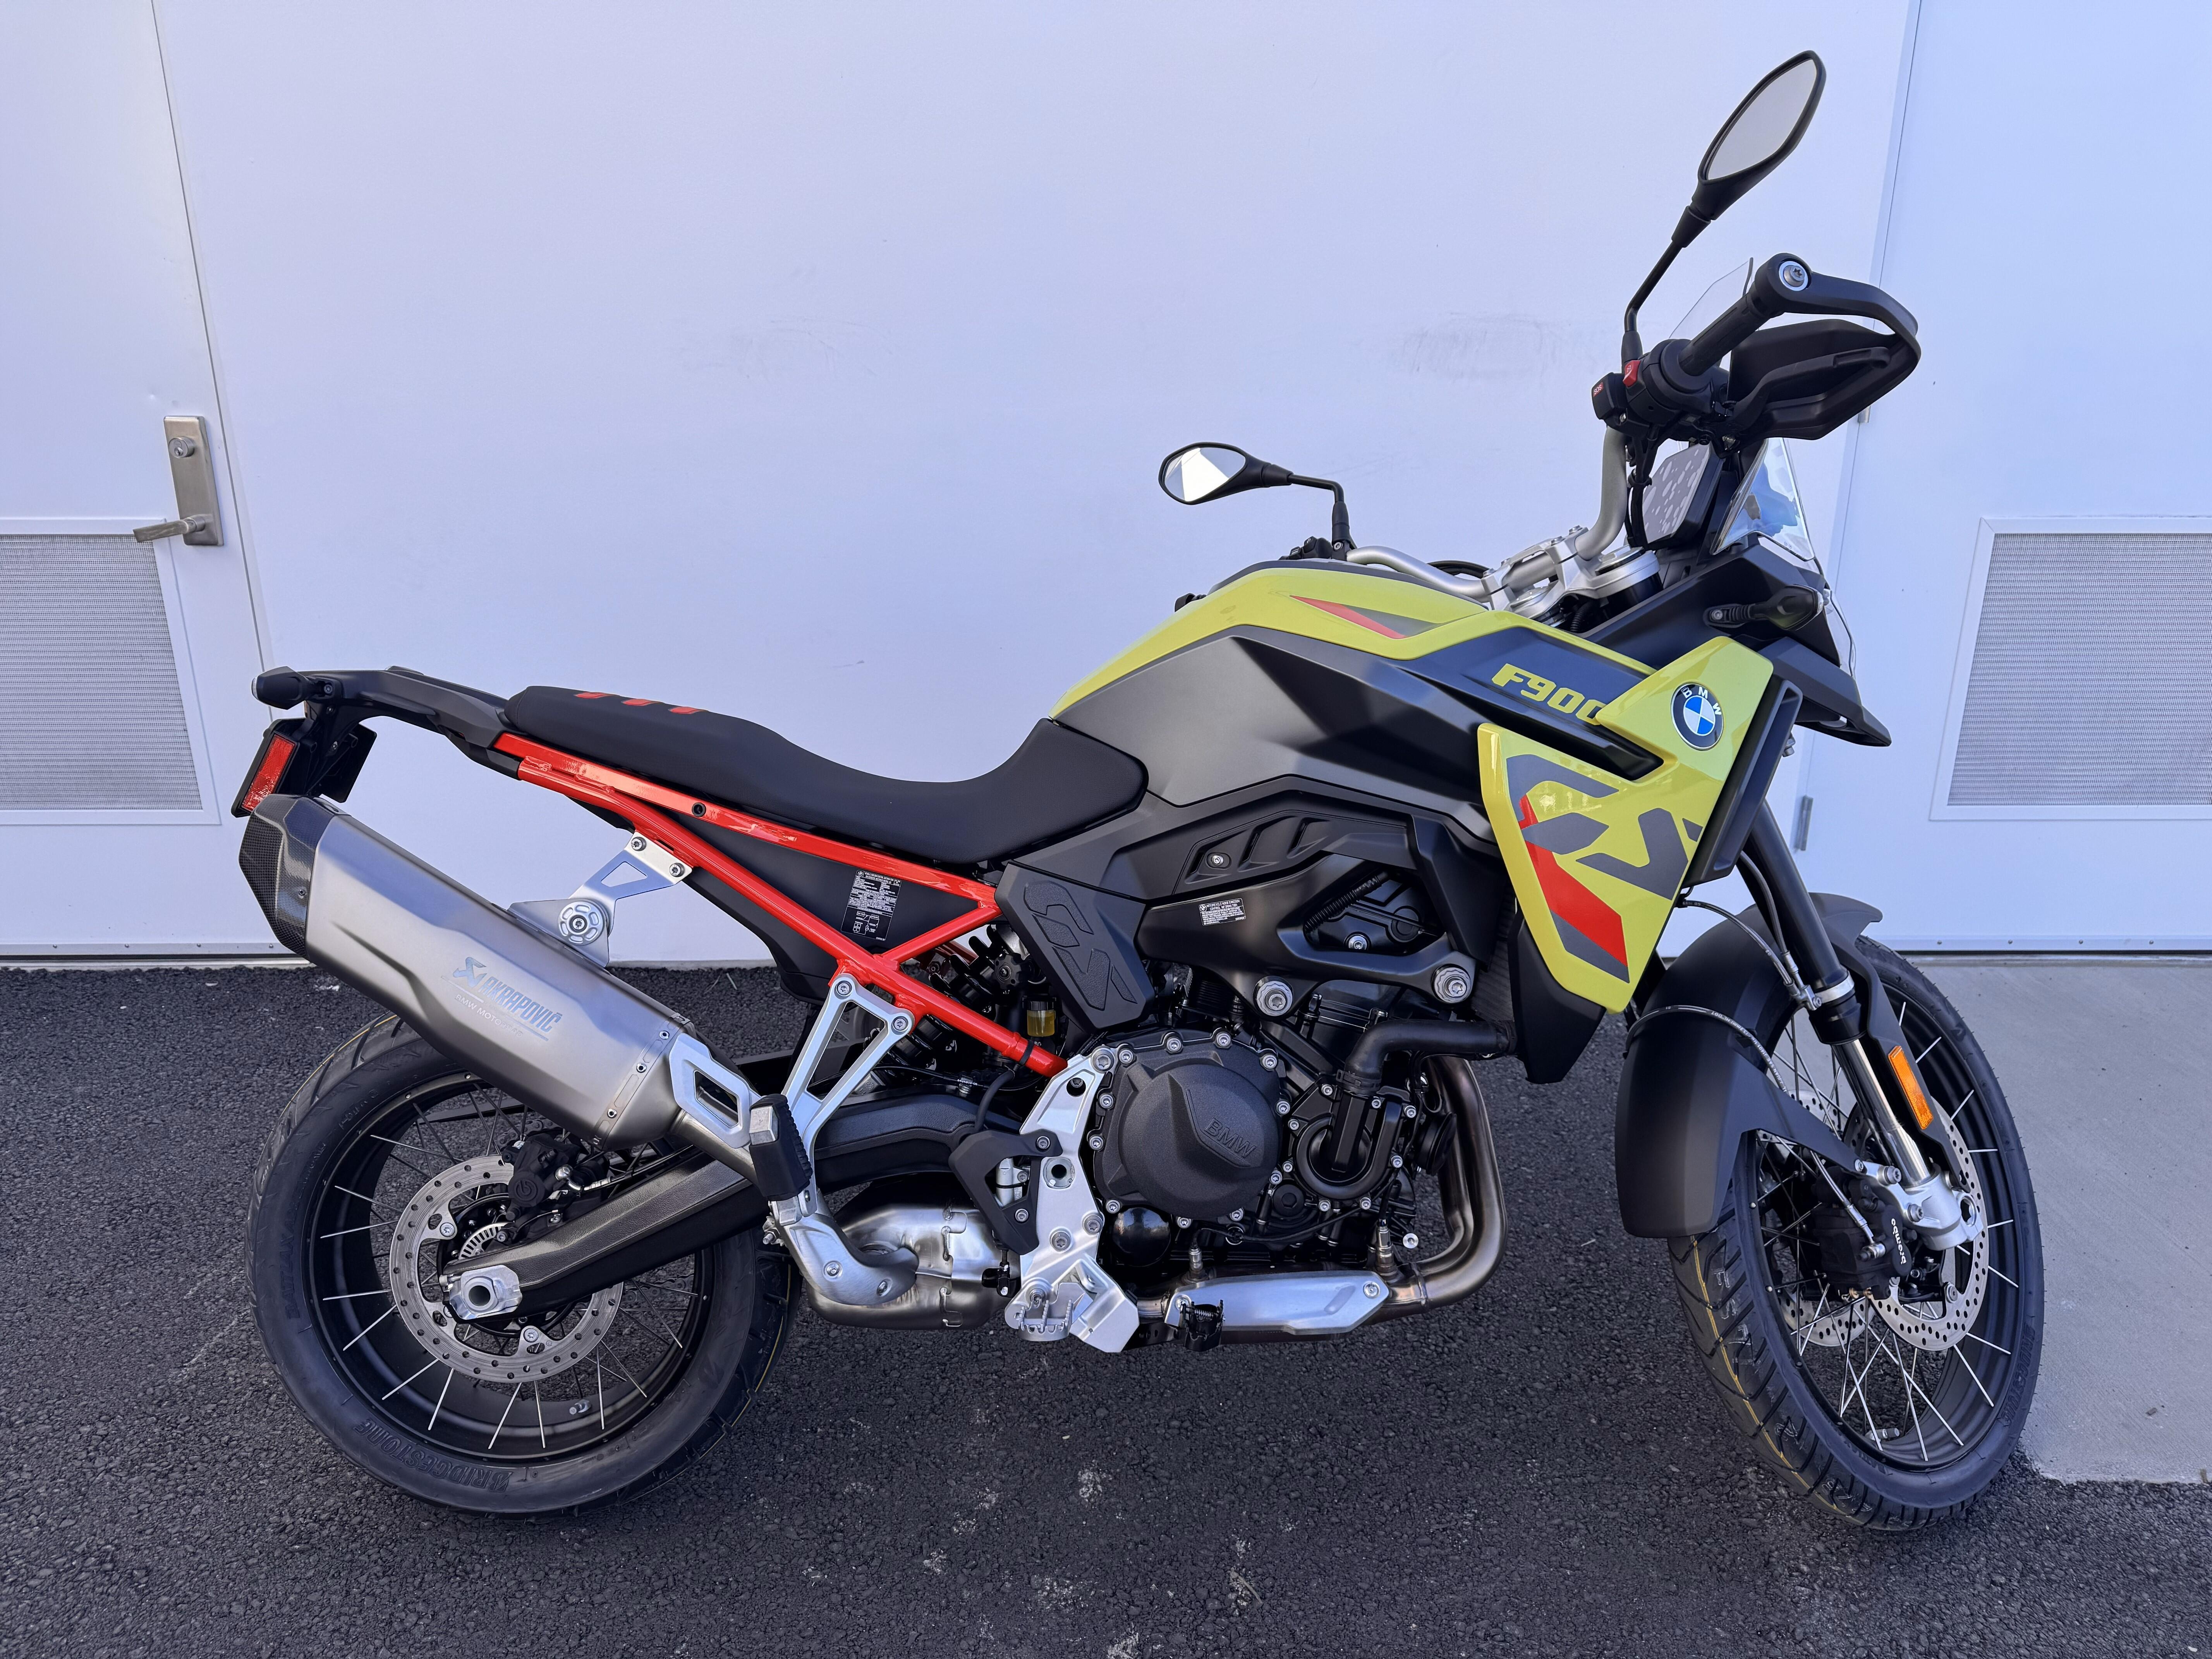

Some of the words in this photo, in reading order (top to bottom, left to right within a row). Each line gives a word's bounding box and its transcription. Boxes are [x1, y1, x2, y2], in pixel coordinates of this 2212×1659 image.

[1594, 384, 1602, 395] SOS
[1681, 686, 1722, 716] BMW
[455, 994, 477, 1010] BMW
[477, 1007, 524, 1037] MOTORRAD
[1204, 1118, 1256, 1158] BMW
[1891, 1218, 1906, 1264] brembo
[353, 1418, 514, 1493] BRIDGESTONE
